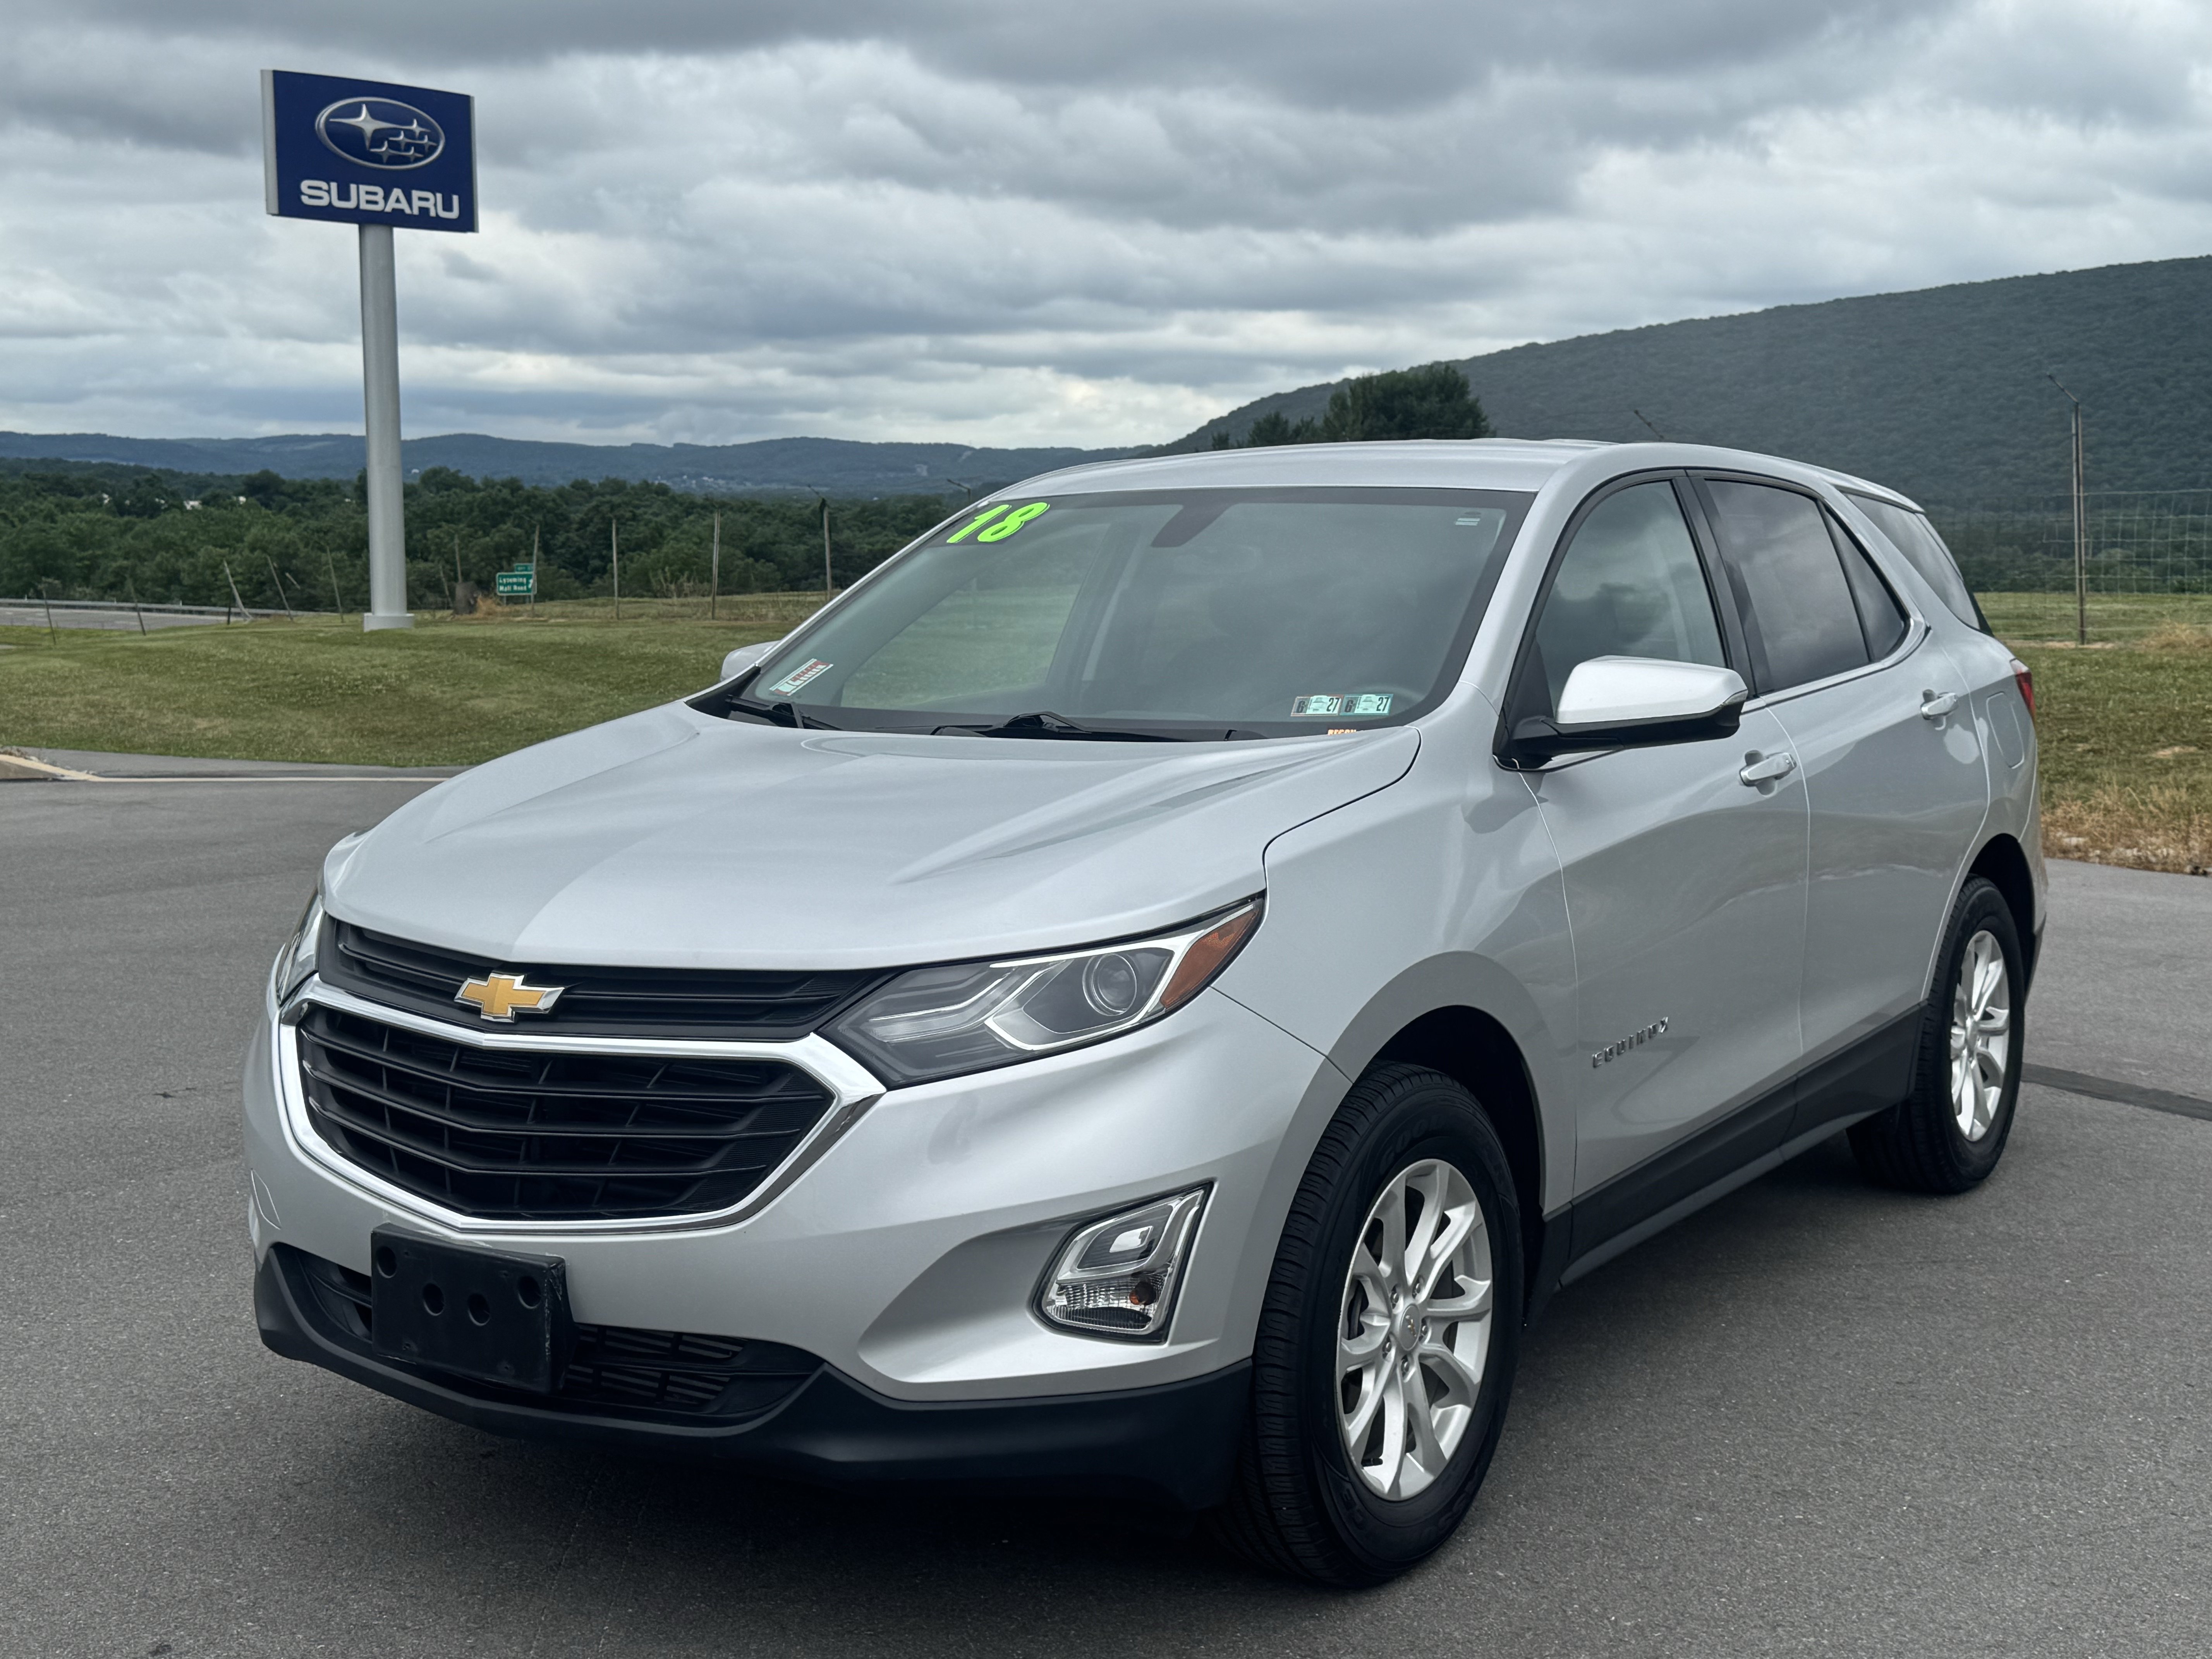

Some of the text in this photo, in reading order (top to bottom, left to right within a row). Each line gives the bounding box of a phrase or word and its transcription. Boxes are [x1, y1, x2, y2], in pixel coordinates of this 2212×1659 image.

[300, 179, 460, 220] SUBARU
[946, 502, 1050, 543] 18
[1326, 697, 1340, 713] 27
[1376, 697, 1389, 712] 27
[1592, 1017, 1668, 1068] EQUINOX
